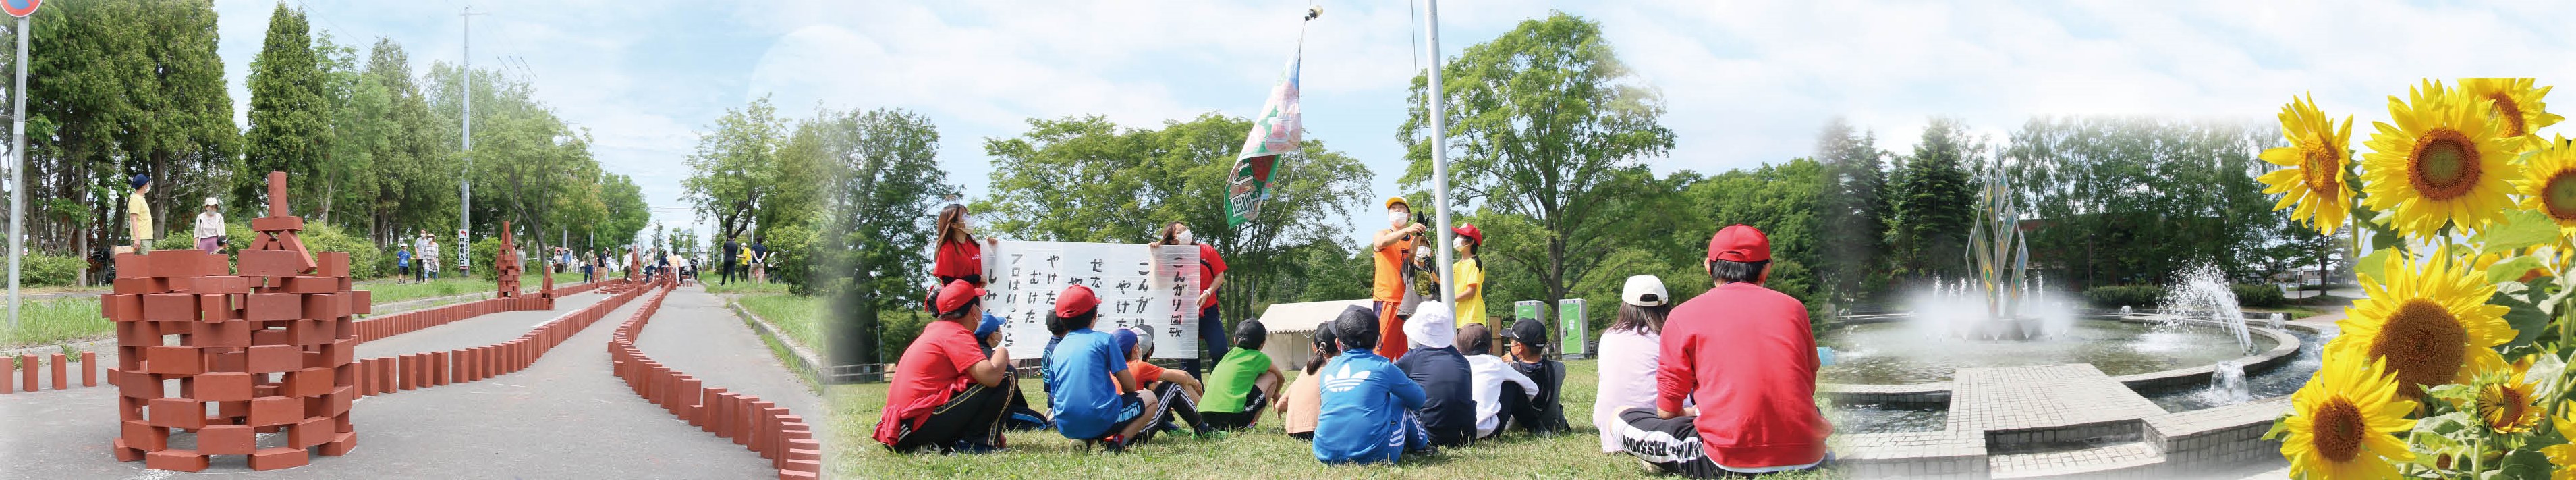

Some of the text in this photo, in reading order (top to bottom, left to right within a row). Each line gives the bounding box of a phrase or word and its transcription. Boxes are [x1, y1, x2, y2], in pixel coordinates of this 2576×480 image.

[984, 269, 997, 314] しみ
[1025, 270, 1042, 324] むけた
[1045, 255, 1059, 325] やけた
[1168, 257, 1188, 338] こんがり国歌
